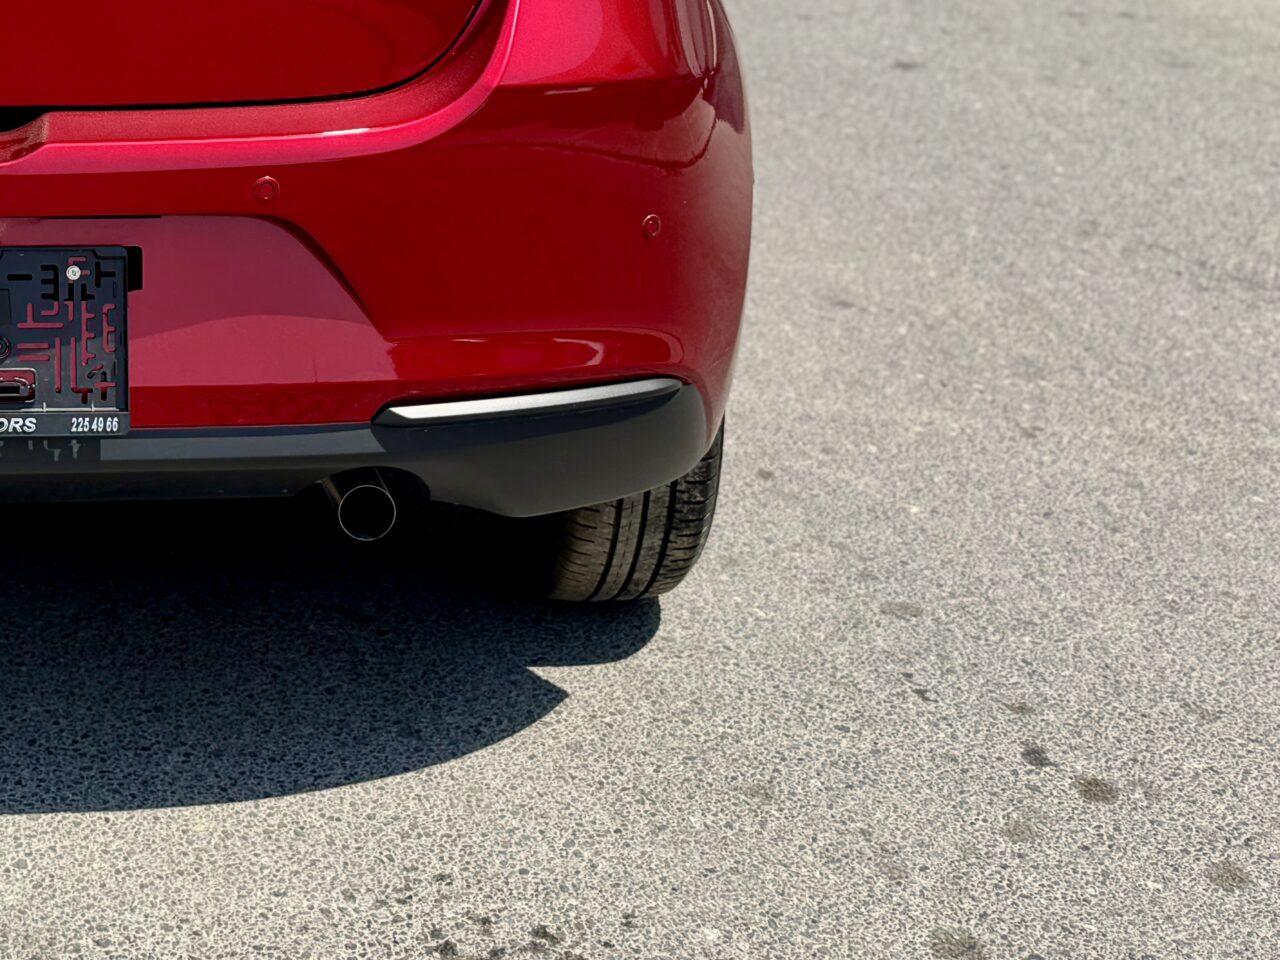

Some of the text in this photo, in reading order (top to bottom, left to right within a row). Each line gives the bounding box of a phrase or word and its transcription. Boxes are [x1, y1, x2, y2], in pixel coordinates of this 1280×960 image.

[71, 416, 119, 433] 225 49 66
